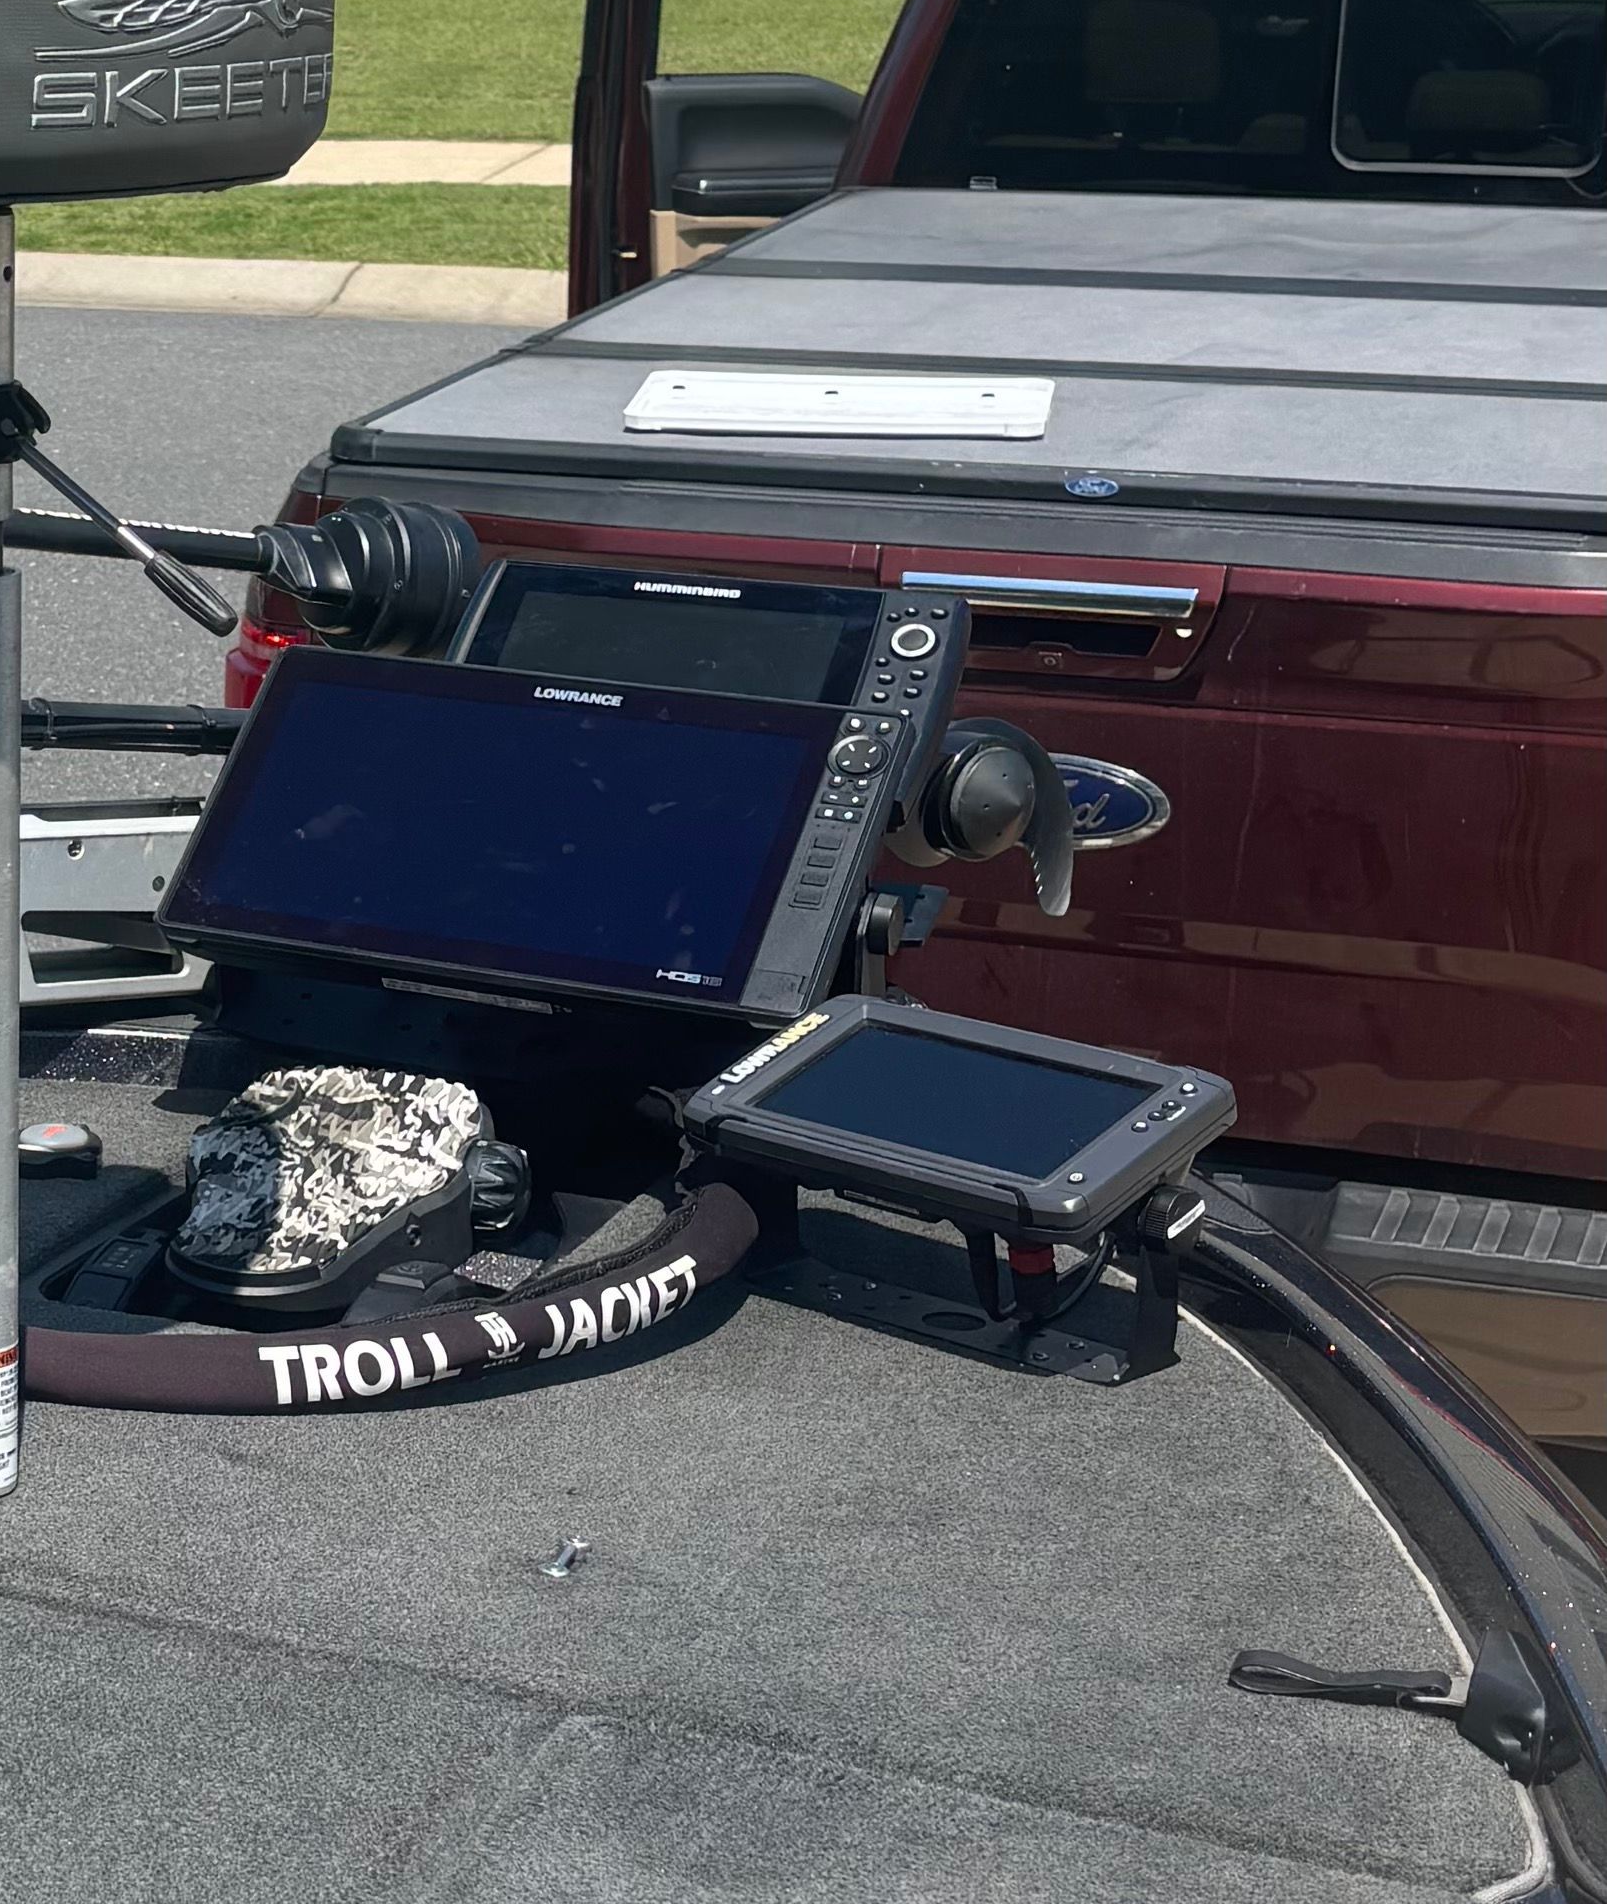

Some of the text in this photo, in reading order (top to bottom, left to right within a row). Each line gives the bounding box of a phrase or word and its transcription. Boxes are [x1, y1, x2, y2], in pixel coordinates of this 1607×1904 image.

[634, 582, 741, 599] HUMMINBIRD
[534, 687, 624, 707] LOWRANCE
[258, 1331, 462, 1405] TROLL
[538, 1254, 697, 1360] JACKET
